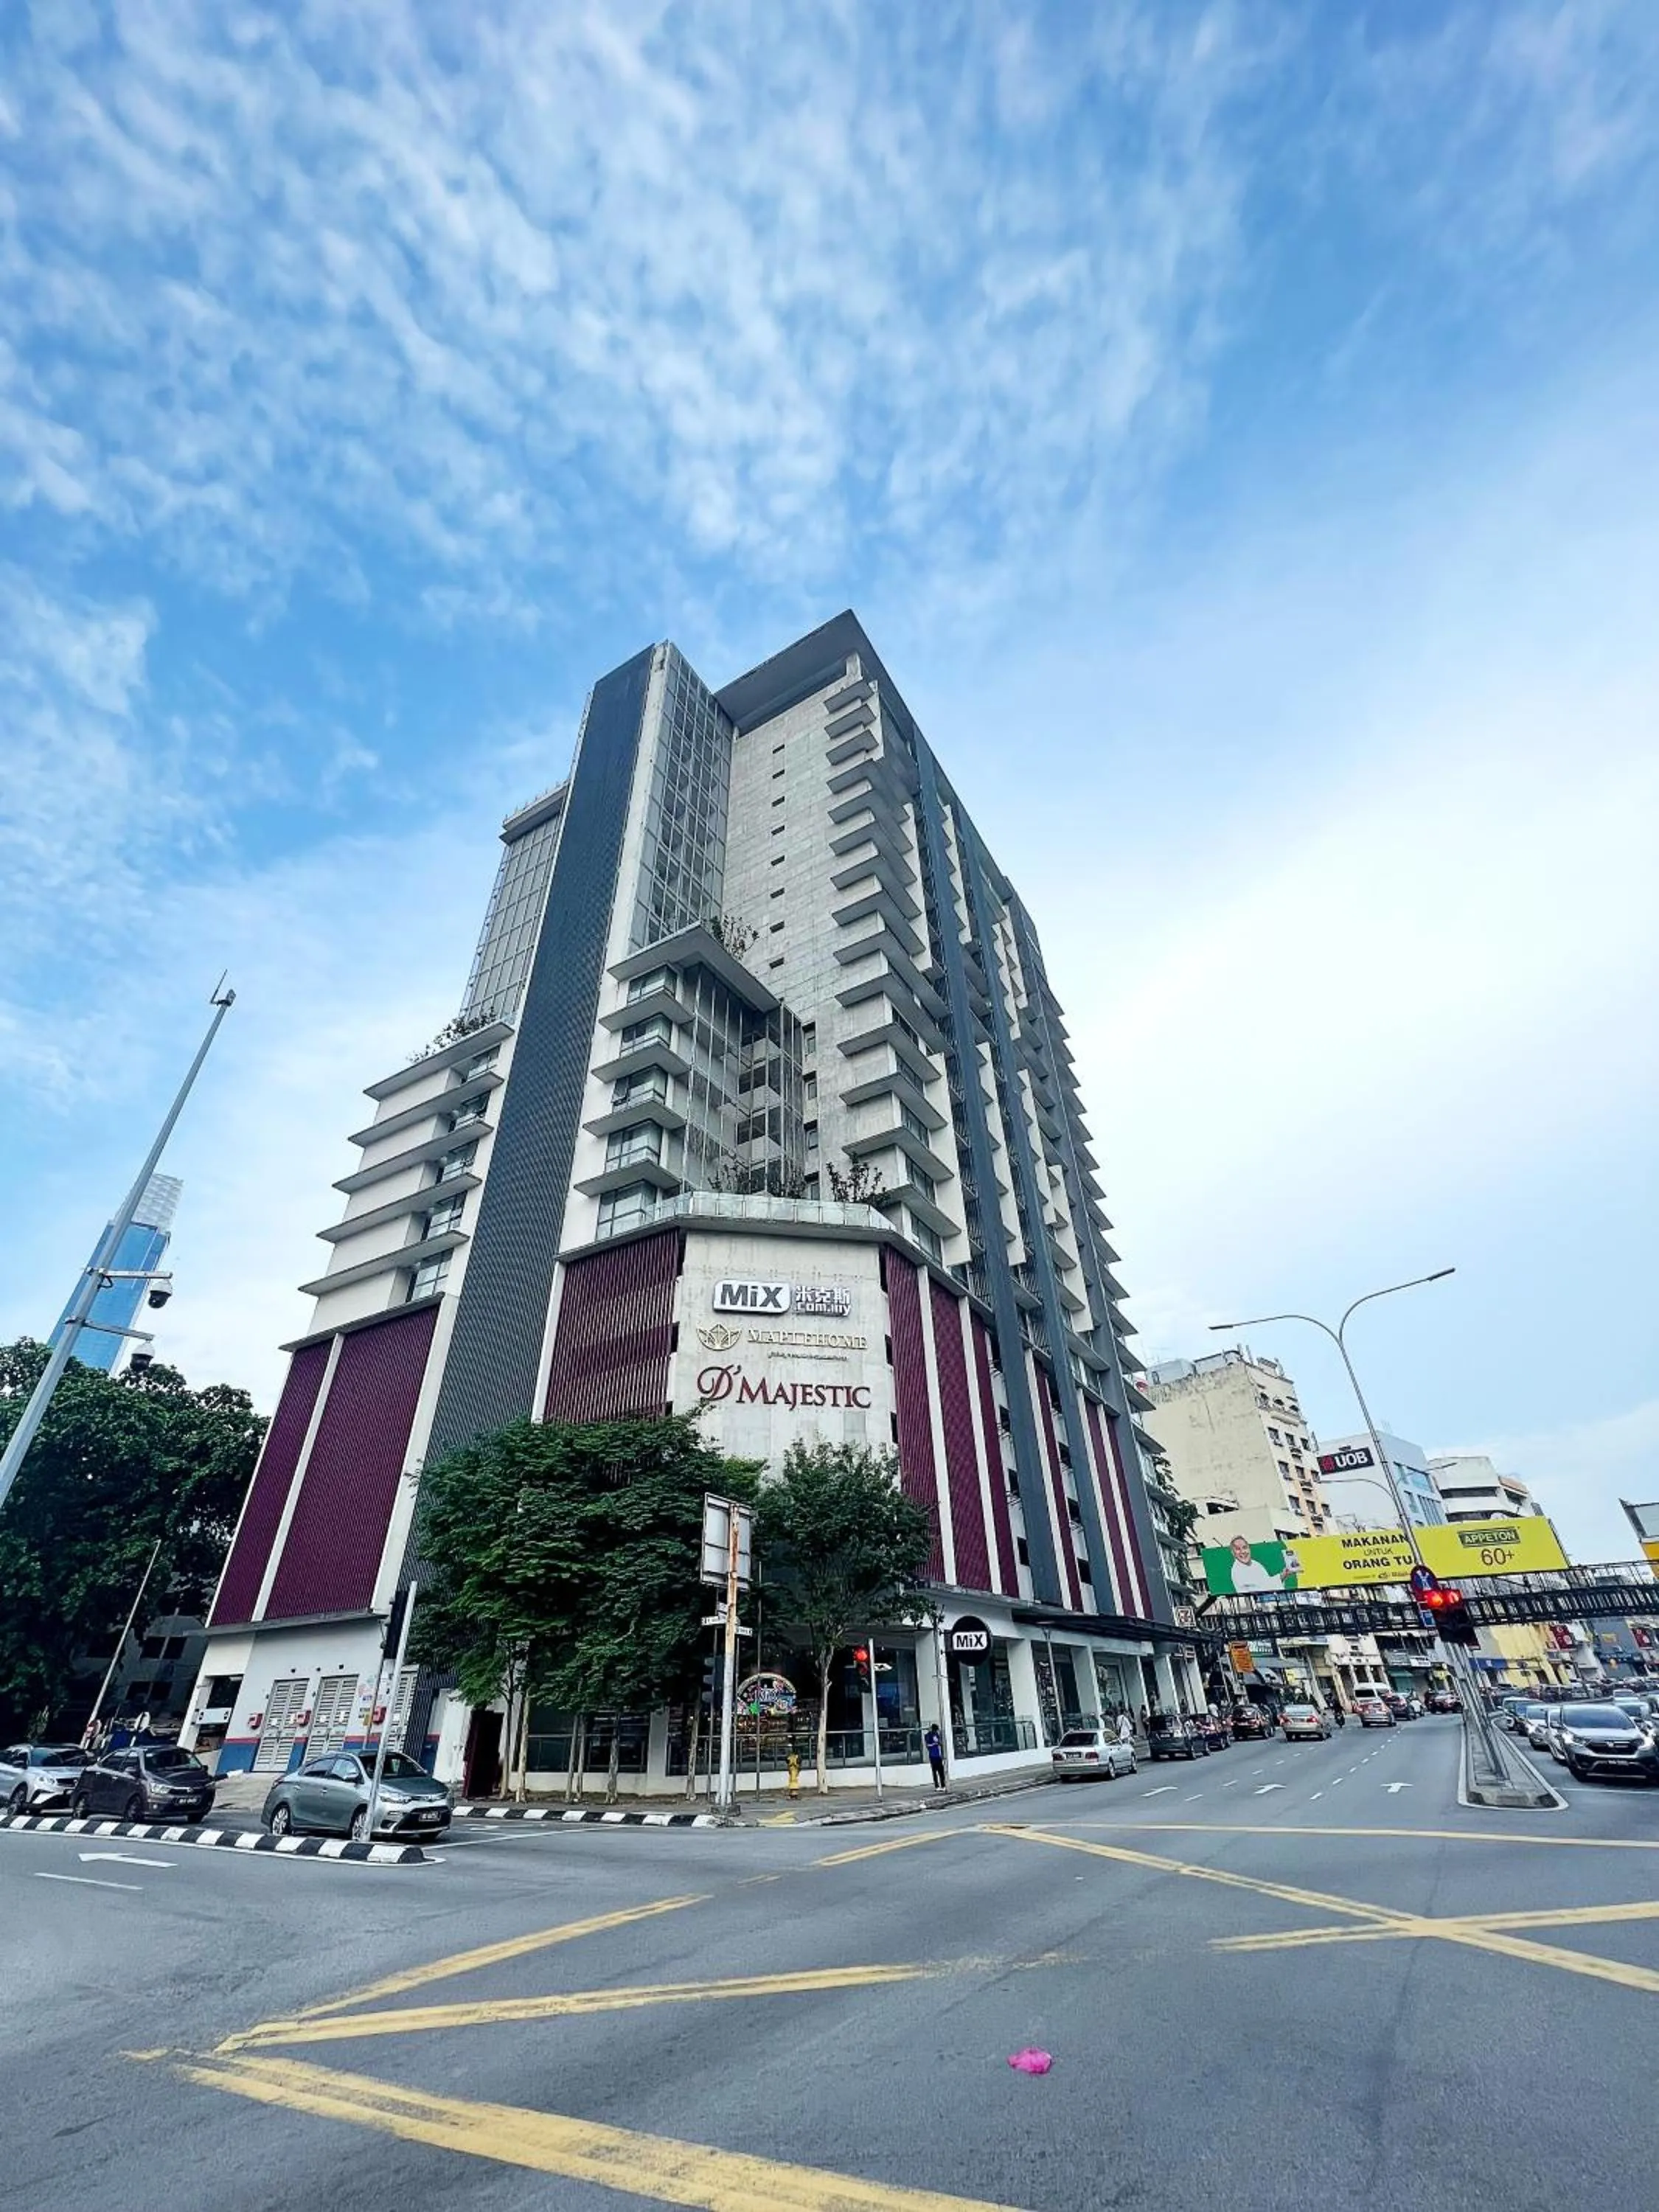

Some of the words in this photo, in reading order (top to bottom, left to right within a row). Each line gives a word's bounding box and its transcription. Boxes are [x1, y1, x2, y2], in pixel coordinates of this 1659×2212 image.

[720, 1284, 783, 1309] MiX
[796, 1285, 850, 1304] 米克斯
[1334, 1450, 1368, 1468] UOB
[1464, 1531, 1516, 1544] APPETON
[1363, 1547, 1394, 1557] UNTUK
[1481, 1548, 1515, 1566] 60+
[1343, 1557, 1391, 1570] ORANG
[1393, 1554, 1418, 1565] TU
[956, 1633, 984, 1648] MiX
